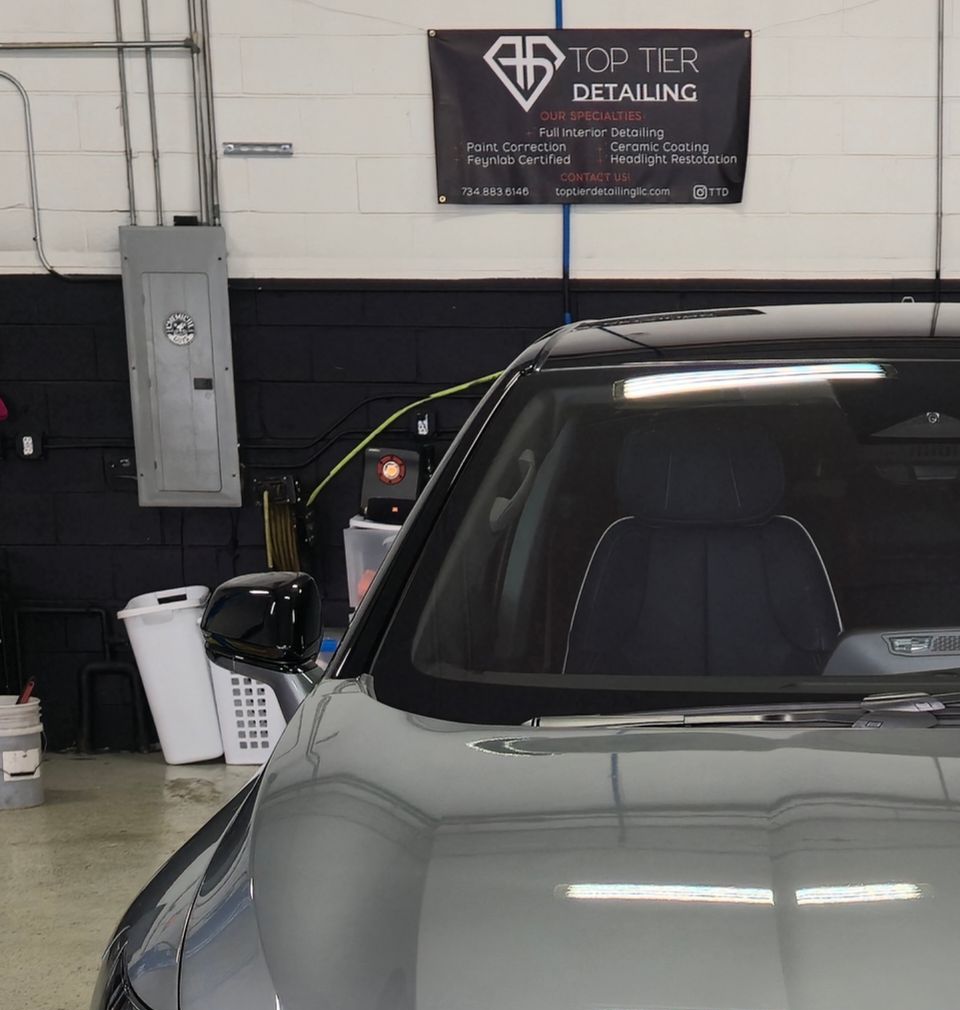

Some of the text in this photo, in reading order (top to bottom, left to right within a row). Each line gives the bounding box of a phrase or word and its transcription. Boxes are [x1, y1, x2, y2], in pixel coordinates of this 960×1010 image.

[568, 47, 700, 73] TOP TIER
[572, 83, 698, 101] DETAILING
[540, 111, 566, 121] OUR
[539, 127, 665, 140] Full Interior Detailing
[466, 142, 567, 152] Paint Correction
[610, 142, 710, 154] Ceramic Coating
[467, 154, 571, 167] Feynlab Certified
[610, 154, 667, 166] Headlight
[560, 173, 610, 182] CONTACT
[555, 186, 671, 198] toptierdetailingllc.com
[708, 187, 729, 197] TTD
